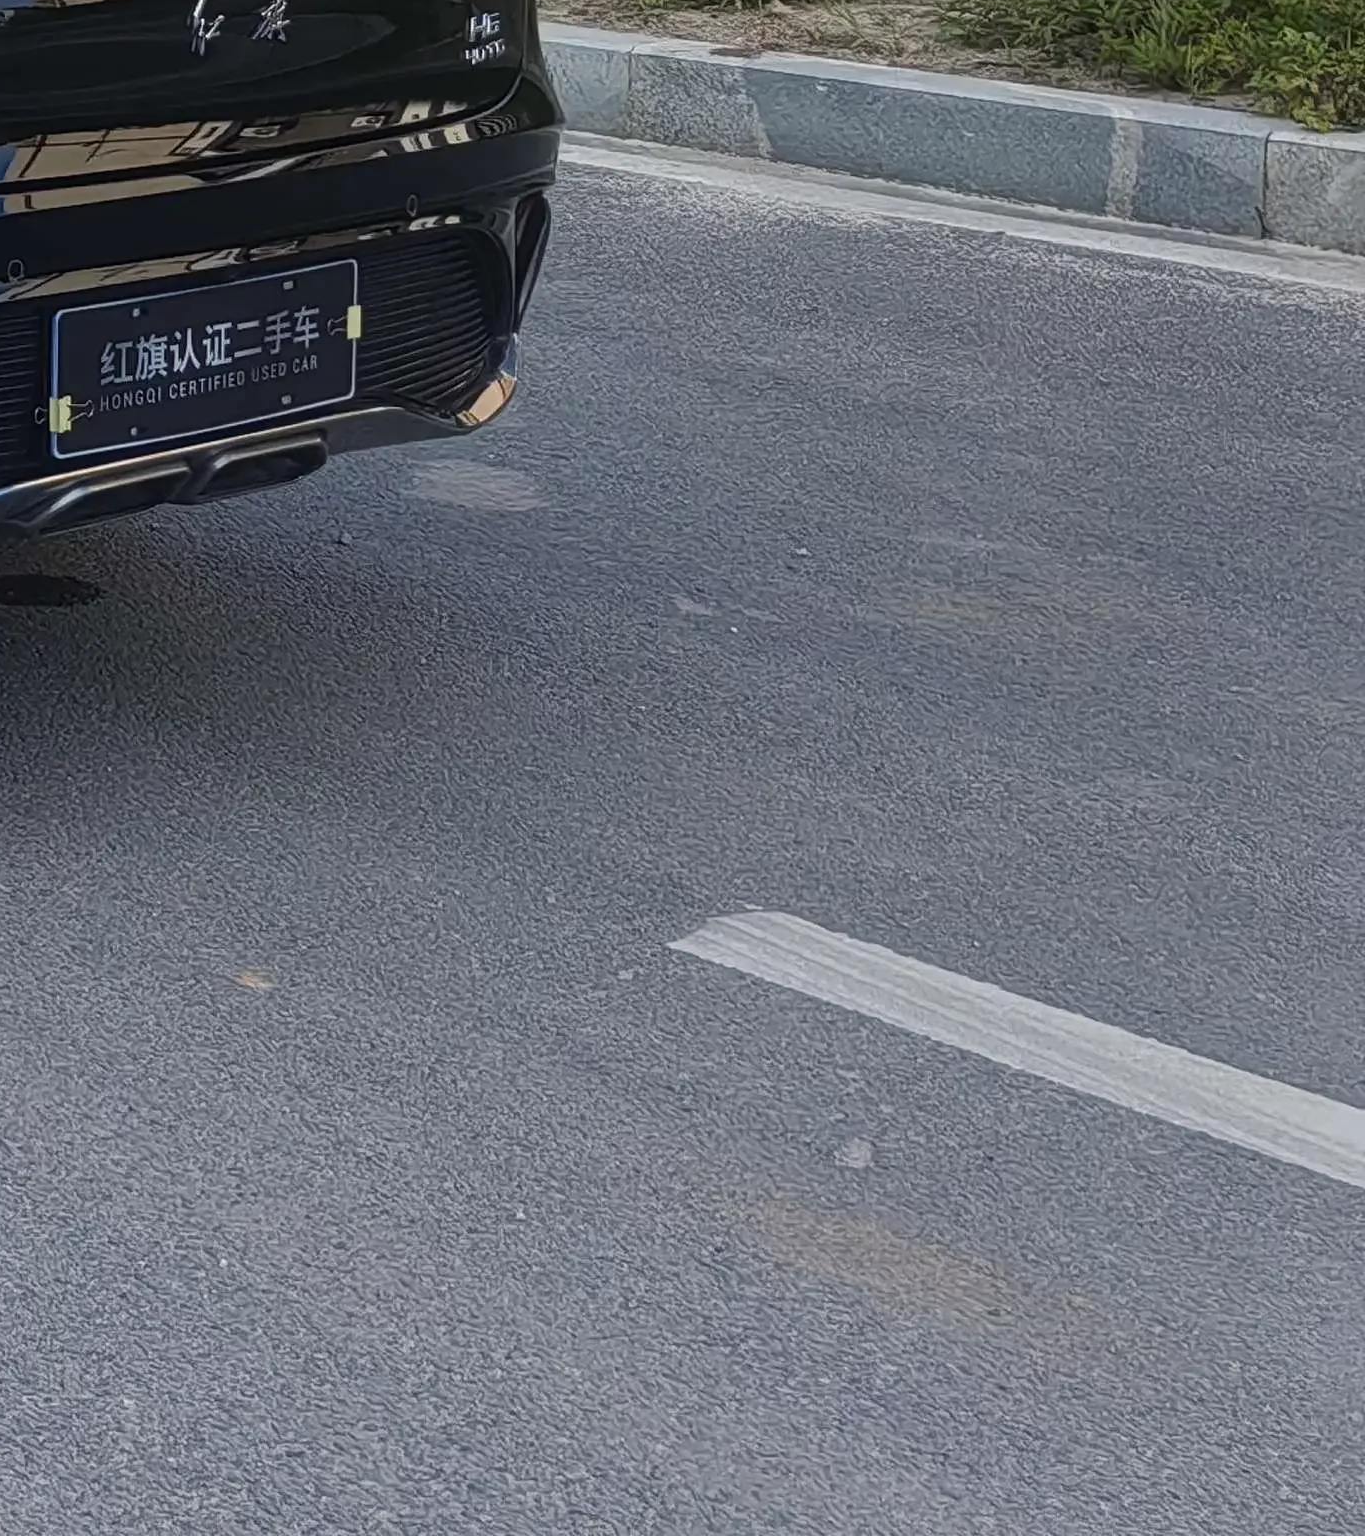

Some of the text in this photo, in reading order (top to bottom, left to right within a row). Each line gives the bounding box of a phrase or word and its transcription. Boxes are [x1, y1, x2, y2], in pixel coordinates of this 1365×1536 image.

[99, 305, 320, 387] 红旗认证二手车
[99, 354, 319, 413] HONGQI CERTIFIED USED CAR
